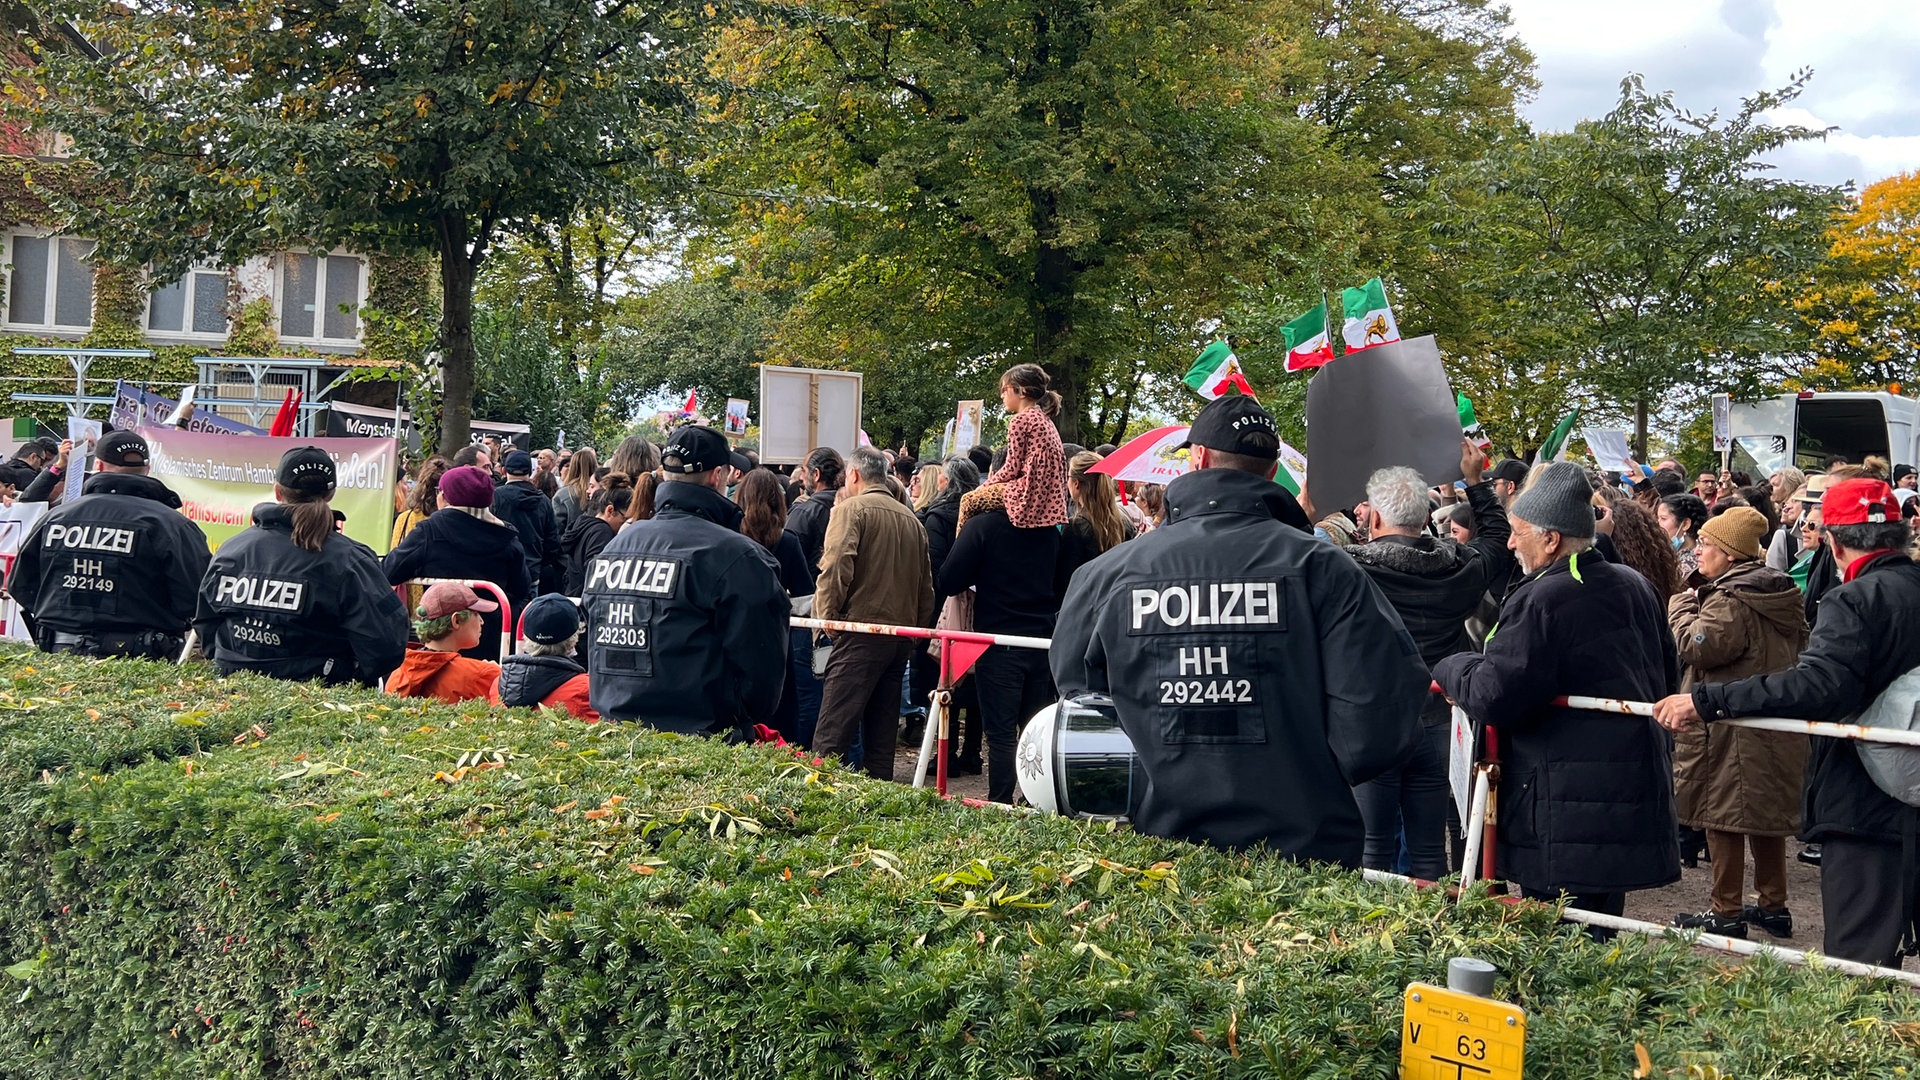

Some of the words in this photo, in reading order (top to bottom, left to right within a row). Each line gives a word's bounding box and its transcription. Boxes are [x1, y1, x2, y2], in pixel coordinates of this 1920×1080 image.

[152, 402, 171, 422] fü
[116, 442, 146, 454] POLIZEI
[206, 459, 244, 483] Zentrum
[245, 461, 276, 484] Hamb
[292, 463, 332, 475] POLIZEI
[330, 452, 386, 491] ießen!
[45, 524, 135, 554] POLIZEI
[74, 559, 103, 577] HH
[588, 559, 677, 594] POLIZEI
[62, 575, 114, 592] 292149
[215, 575, 303, 611] POLIZEI
[607, 603, 634, 625] HH
[1132, 582, 1279, 629] POLIZEI
[233, 625, 281, 646] 292469
[596, 626, 646, 647] 292303
[1179, 646, 1229, 676] HH
[1160, 680, 1252, 704] 292442
[1457, 1011, 1469, 1023] 2a
[1409, 1022, 1421, 1044] V
[1457, 1035, 1486, 1061] 63
